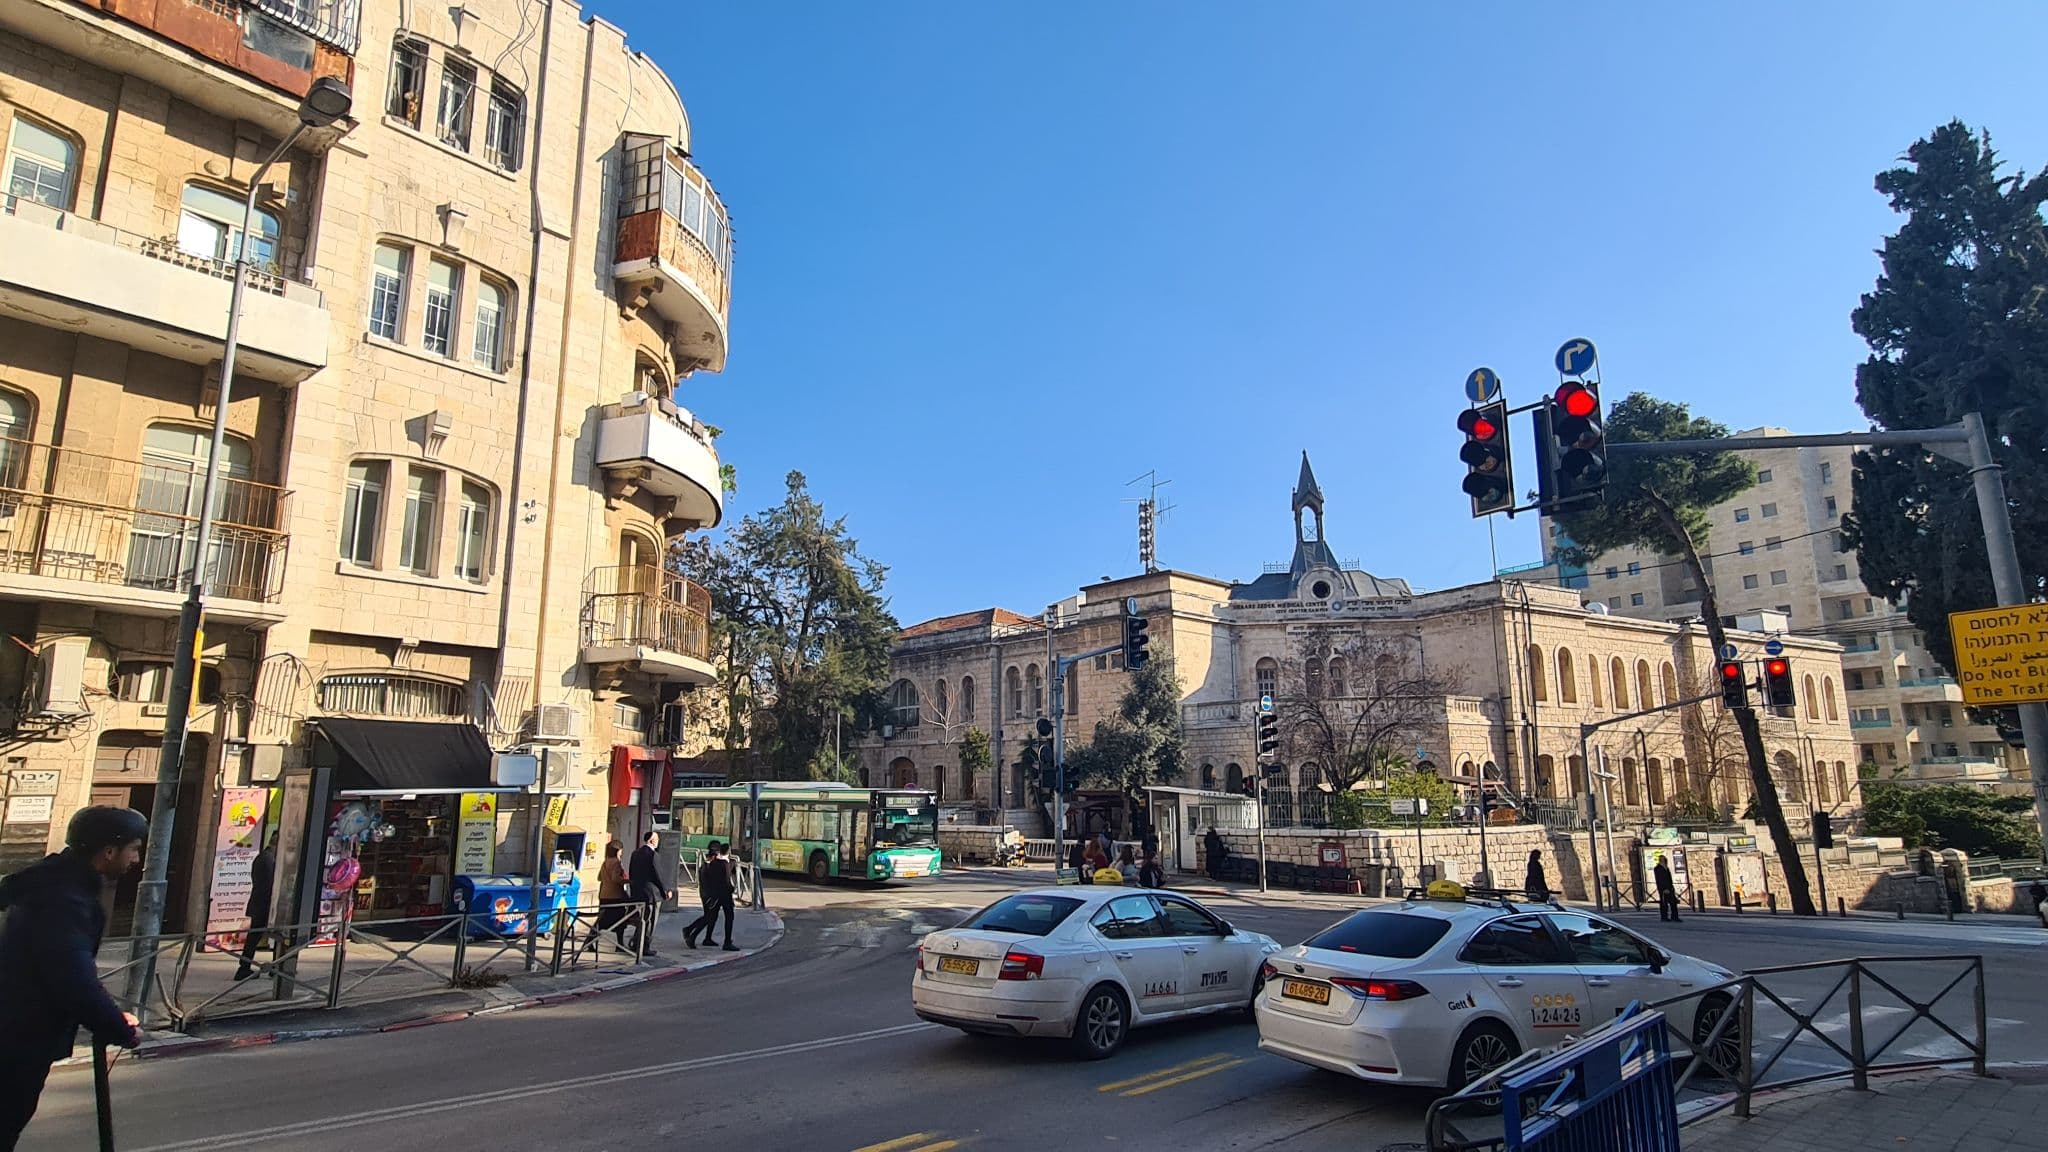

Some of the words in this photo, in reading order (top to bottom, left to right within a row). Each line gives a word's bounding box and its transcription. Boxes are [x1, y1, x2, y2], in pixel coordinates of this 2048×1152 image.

[1969, 613, 2020, 630] לחסום
[2037, 631, 2048, 642] ת
[1964, 671, 1984, 682] Do
[1991, 668, 2020, 679] Not
[2028, 665, 2048, 677] Bl
[1972, 686, 2003, 698] The
[2009, 682, 2048, 695] Traf
